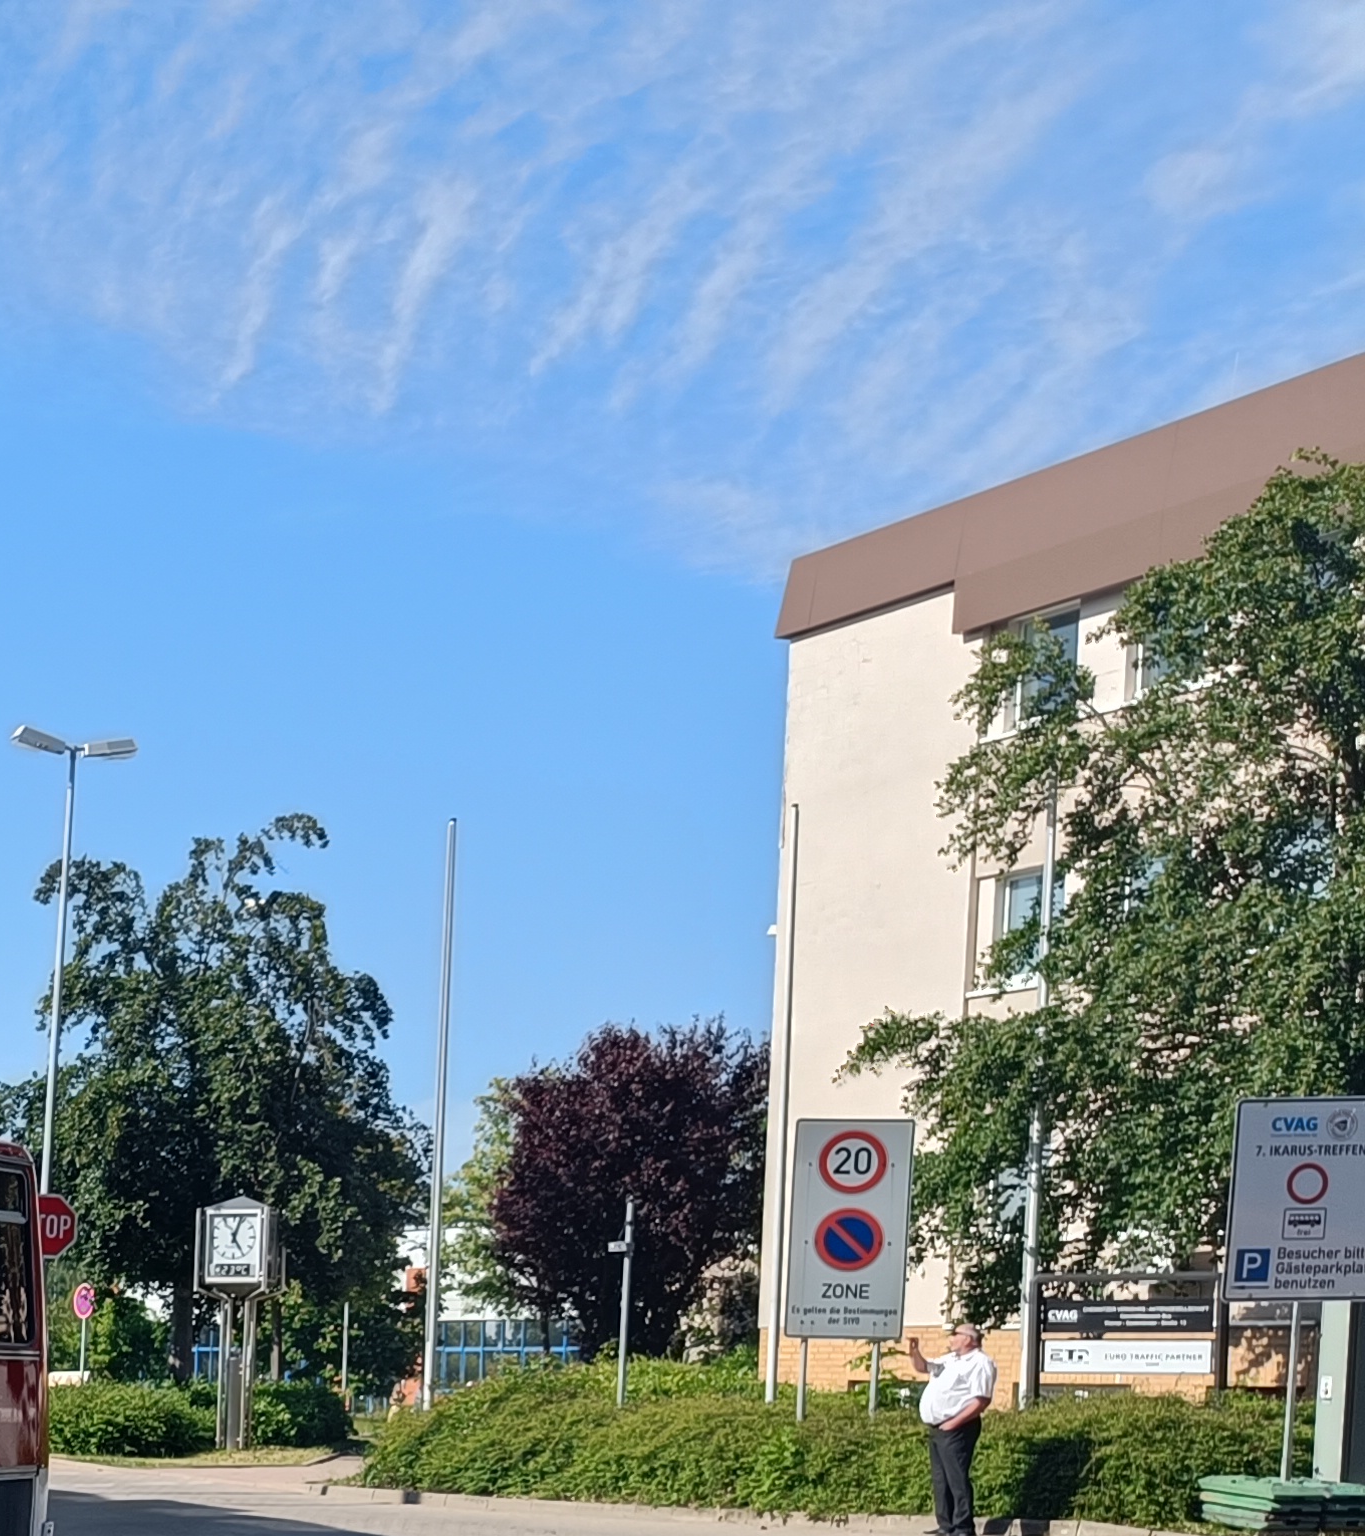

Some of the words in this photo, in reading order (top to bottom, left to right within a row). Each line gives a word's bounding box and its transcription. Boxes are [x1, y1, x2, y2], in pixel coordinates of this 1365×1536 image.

[1271, 1116, 1318, 1132] CVAG
[1255, 1145, 1267, 1158] 7.
[833, 1146, 872, 1175] 20
[1296, 1228, 1312, 1237] frei
[1277, 1246, 1342, 1260] Besucher
[1242, 1252, 1262, 1279] P
[1275, 1260, 1365, 1277] Gästeparkpla
[1274, 1276, 1335, 1290] benutzen
[821, 1283, 871, 1300] ZONE
[1048, 1309, 1078, 1321] CVAG
